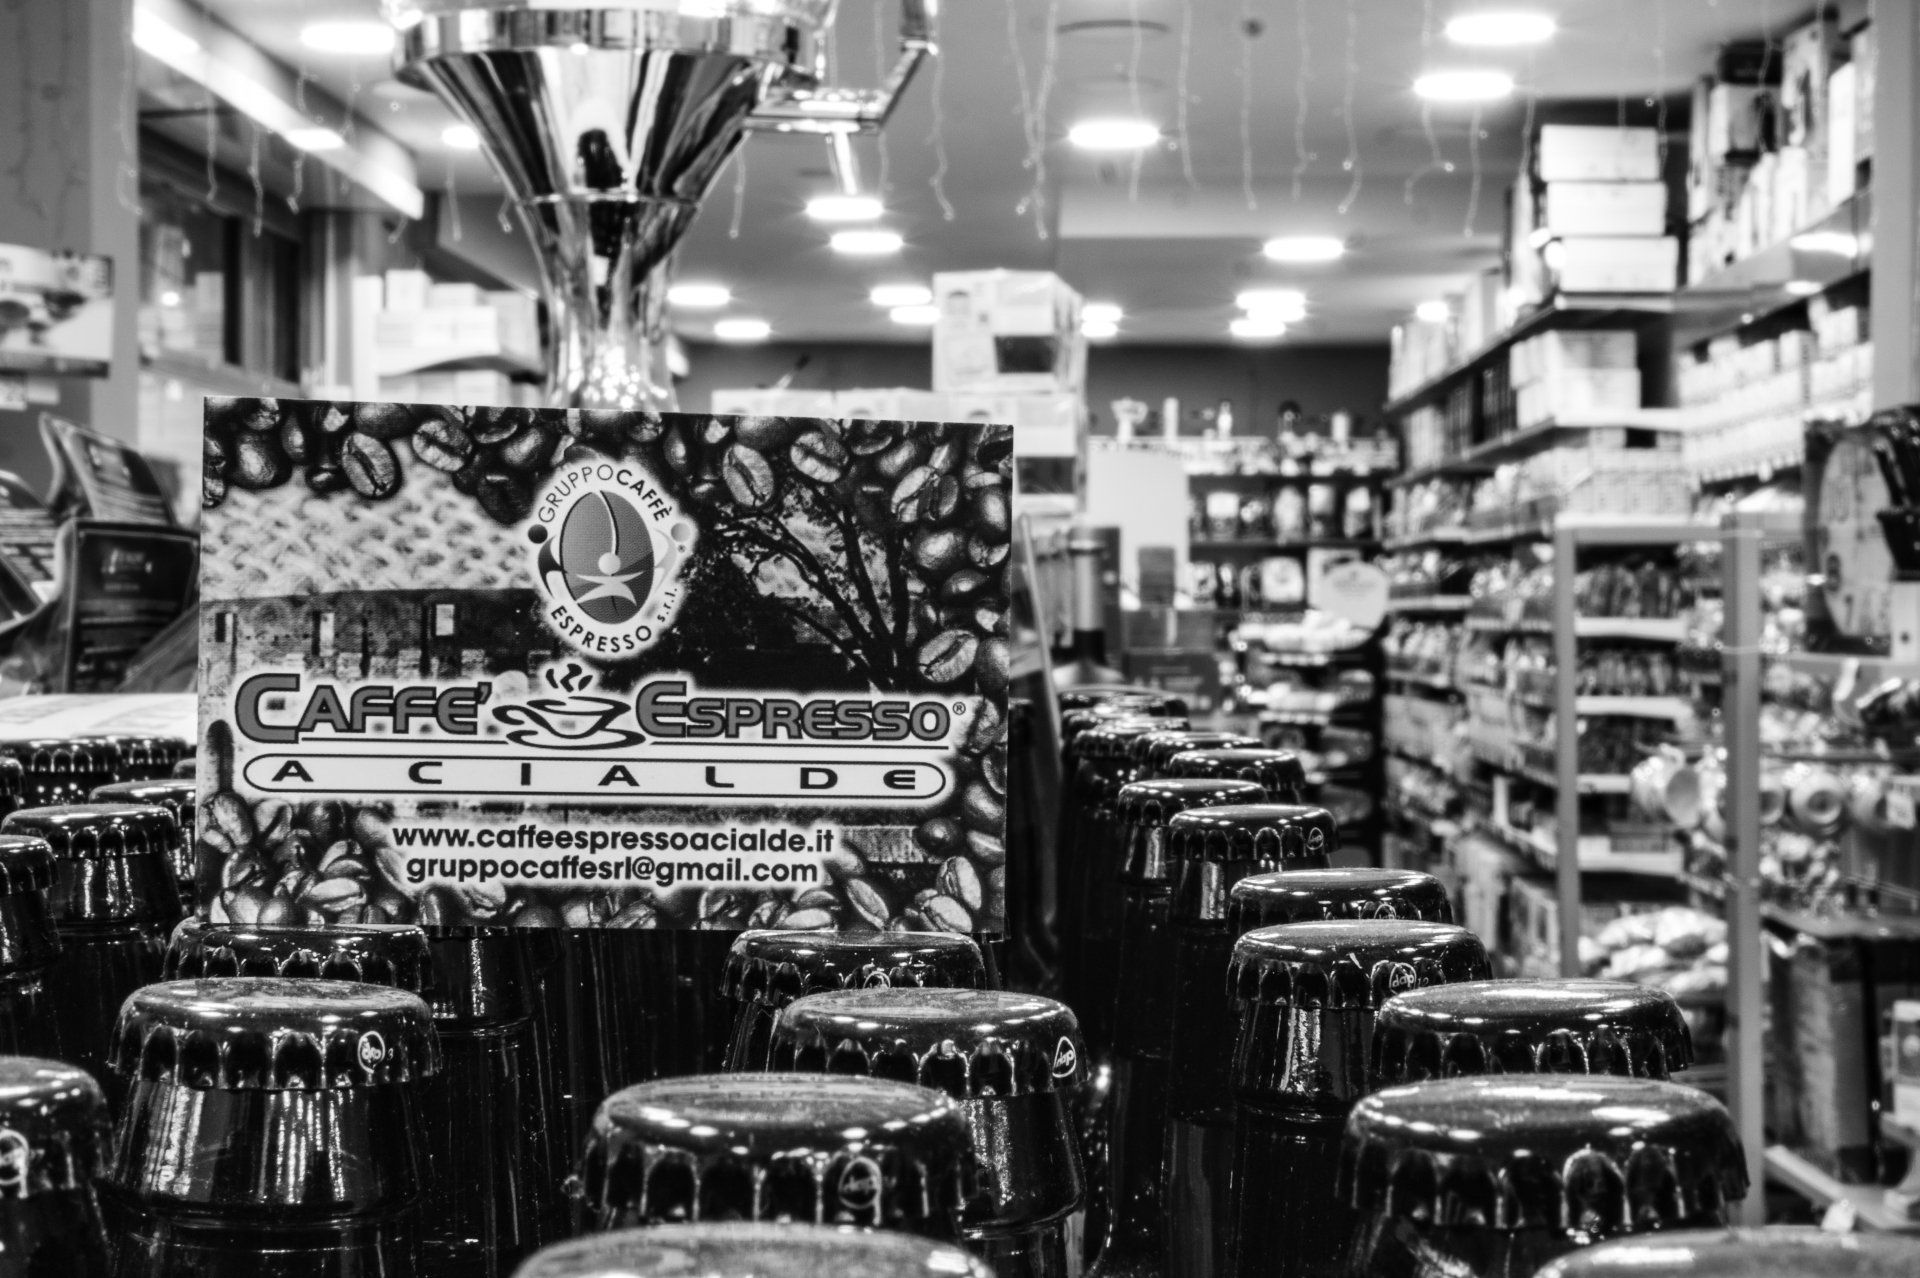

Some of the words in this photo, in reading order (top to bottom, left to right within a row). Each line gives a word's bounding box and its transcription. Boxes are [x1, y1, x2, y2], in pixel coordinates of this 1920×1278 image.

[551, 605, 652, 653] ESPRESSO
[393, 825, 835, 854] www.caffeespressoacialde.it
[406, 856, 818, 886] gruppocaffesrl@gmail.com
